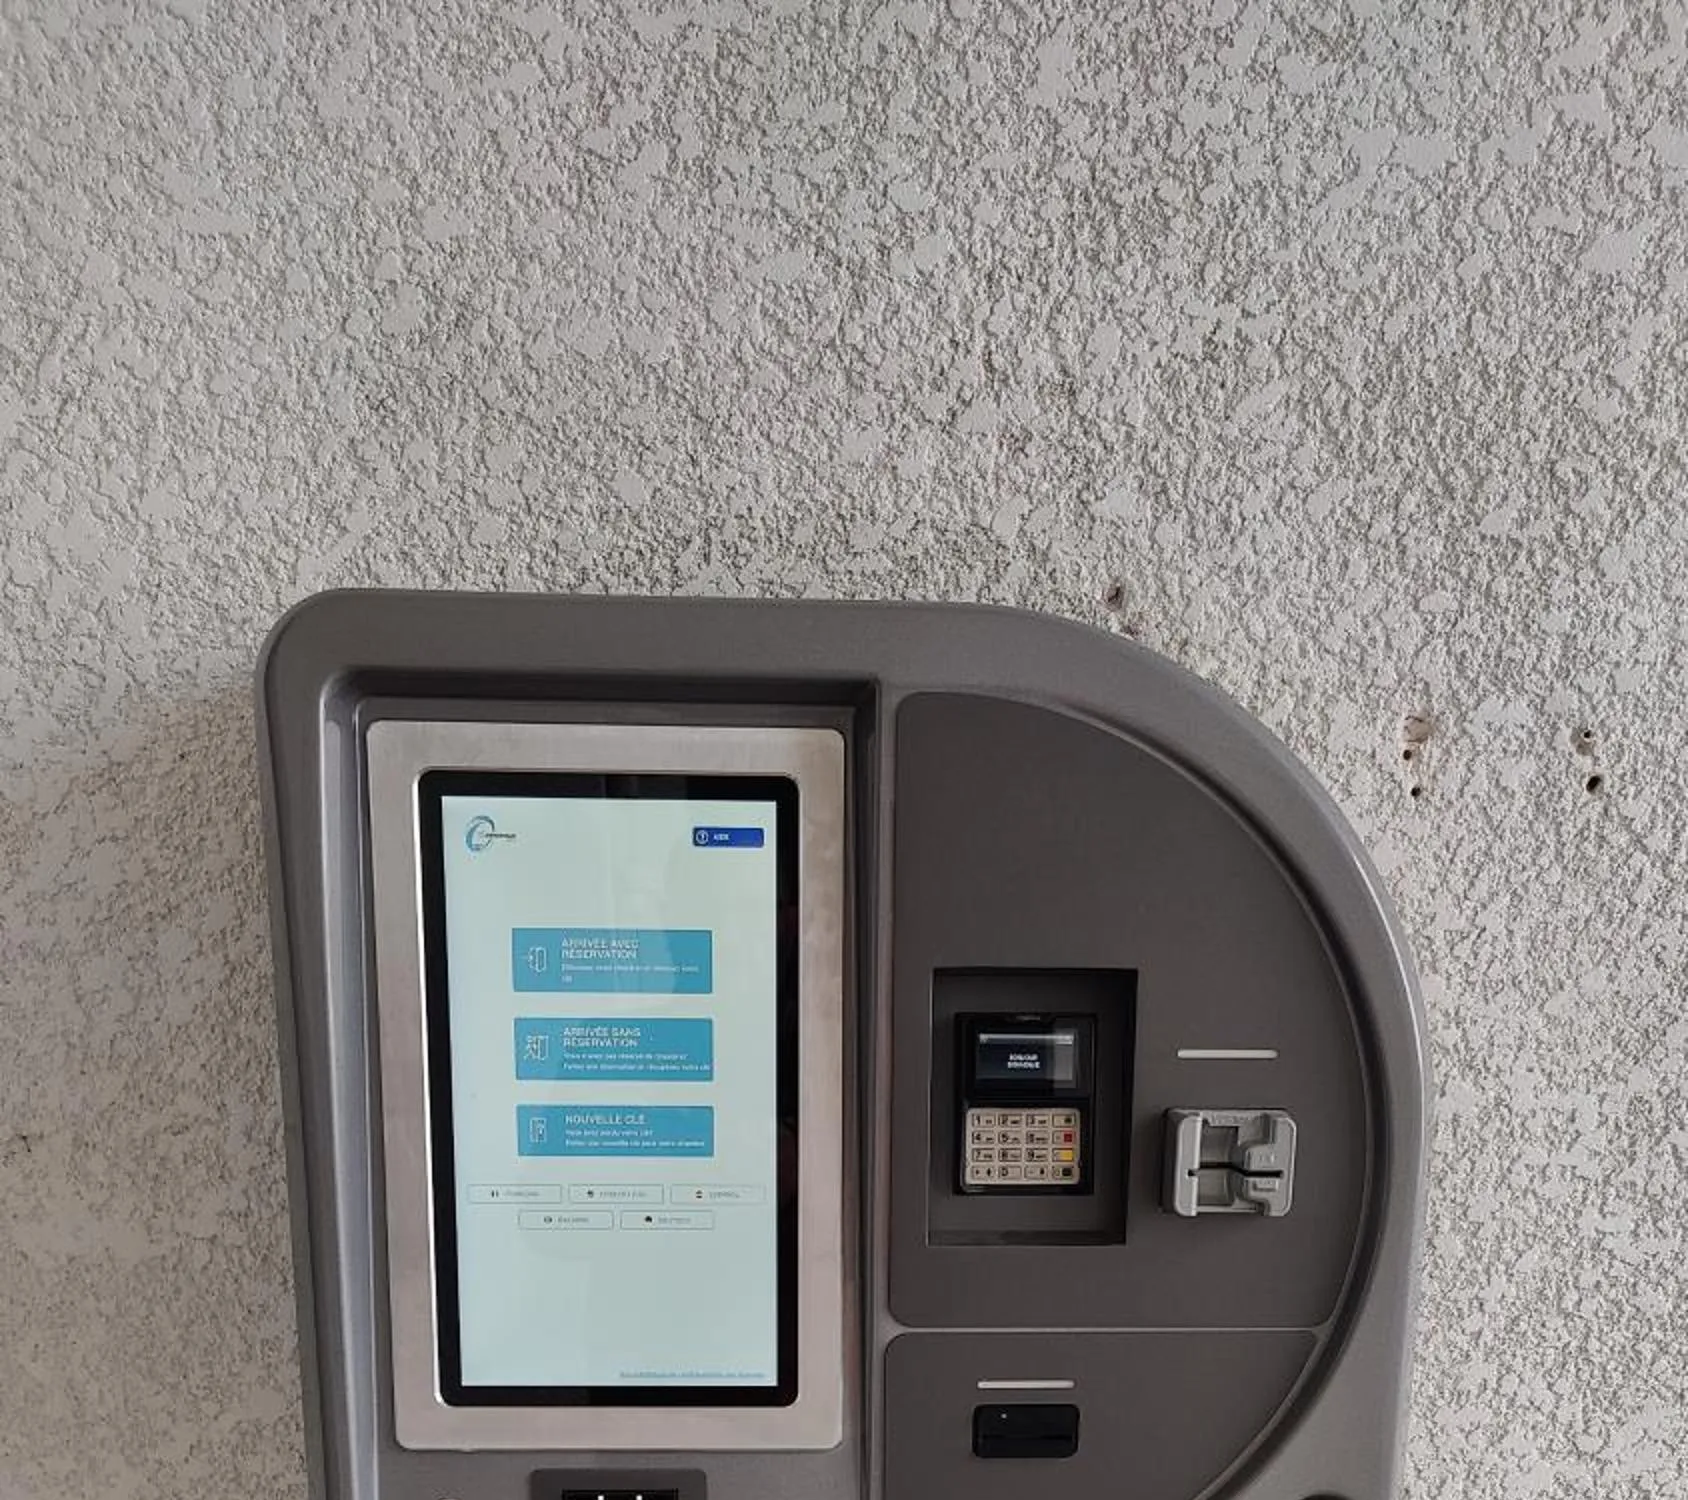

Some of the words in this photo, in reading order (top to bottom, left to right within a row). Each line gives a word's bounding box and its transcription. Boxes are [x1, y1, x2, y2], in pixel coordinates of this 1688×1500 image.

[611, 938, 640, 949] AVEC
[561, 948, 637, 959] RÉSERVATION
[563, 1026, 609, 1037] ARRIVÉE
[611, 1027, 641, 1037] SANS
[563, 1036, 638, 1048] RÉSERVATION
[565, 1114, 622, 1125] NOUVELLE
